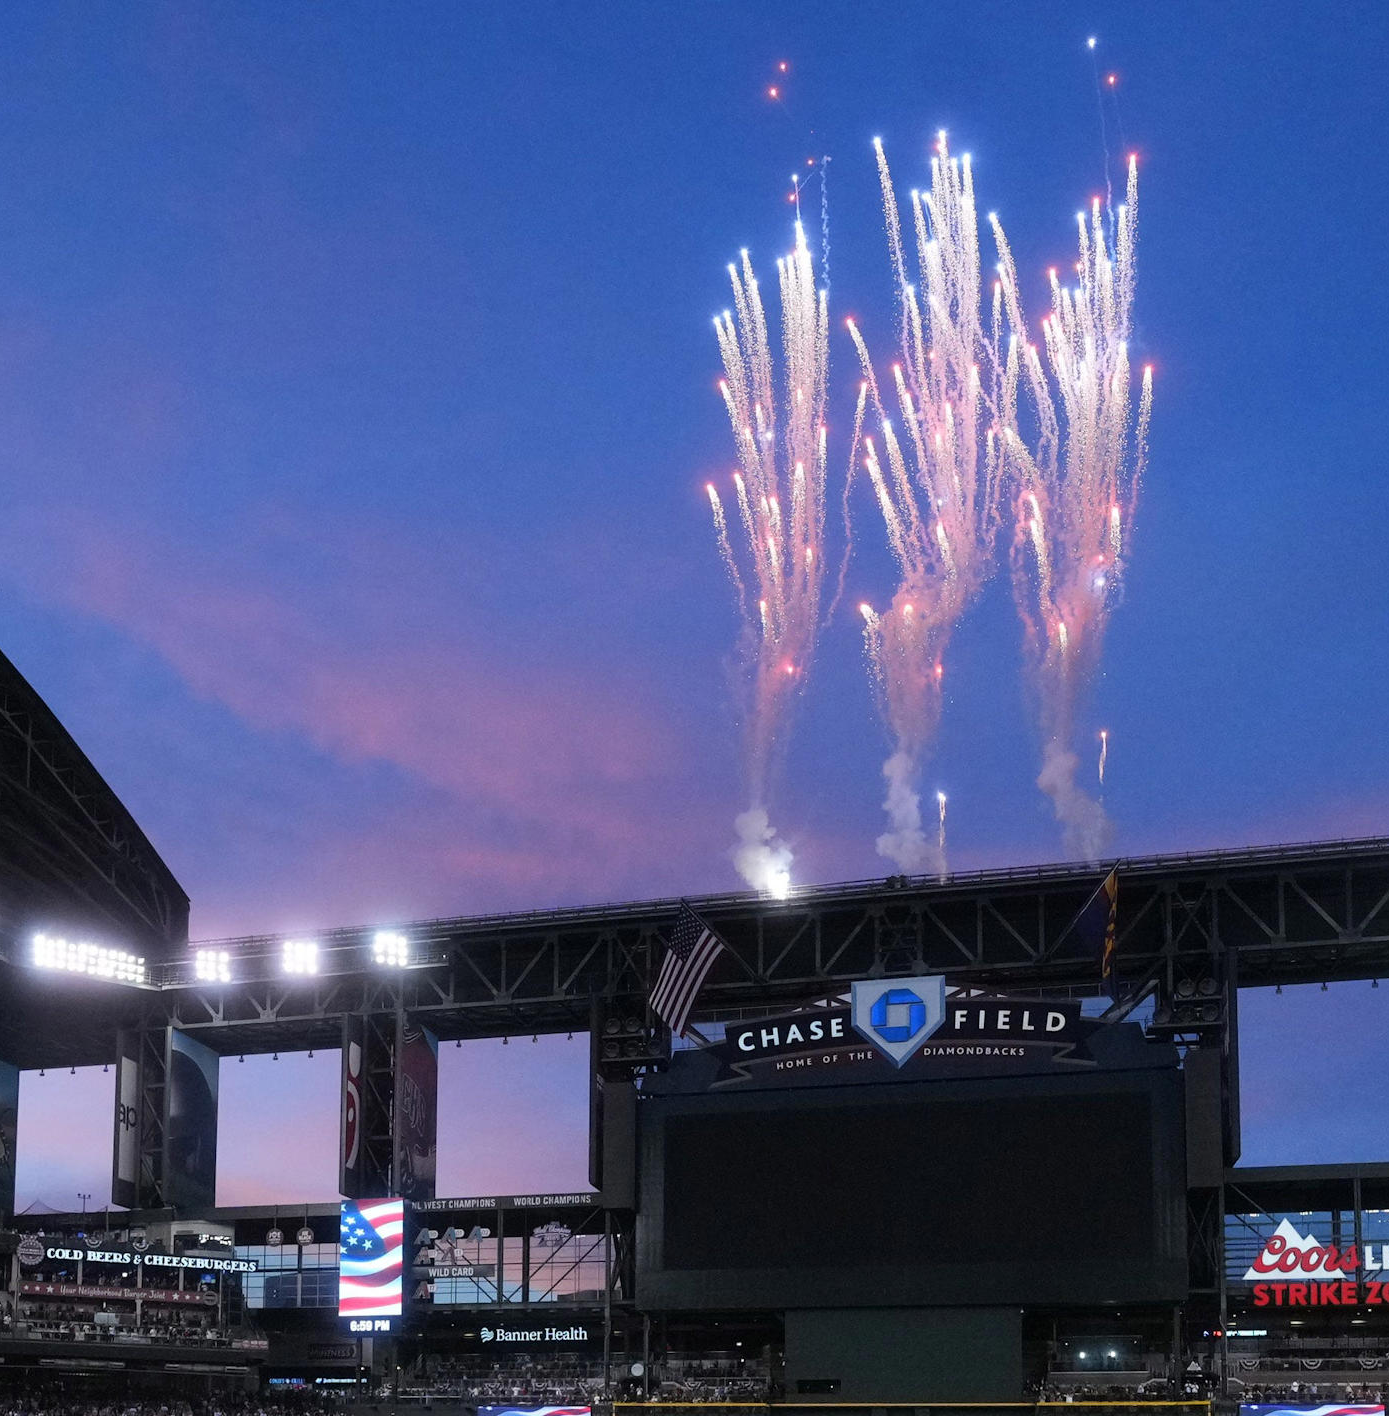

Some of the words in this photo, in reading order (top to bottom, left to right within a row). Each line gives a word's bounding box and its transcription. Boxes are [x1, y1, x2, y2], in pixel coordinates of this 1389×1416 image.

[738, 1017, 845, 1052] CHASE
[954, 1009, 1067, 1032] FIELD
[776, 1057, 813, 1070] HOME
[823, 1055, 839, 1064] OF
[849, 1051, 874, 1062] THE
[923, 1047, 1025, 1056] DIAMONDBACKS
[424, 1200, 446, 1209] WEST
[448, 1199, 496, 1209] CHAMPIONS
[514, 1197, 541, 1206] WORLD
[543, 1195, 592, 1205] CHAMPIONS
[46, 1247, 84, 1260] COLD
[86, 1250, 131, 1264] BEERS
[133, 1254, 142, 1265] &
[144, 1254, 259, 1273] CHEESEBURGERS
[1252, 1235, 1362, 1273] Coors
[429, 1268, 449, 1277] WILD
[451, 1267, 474, 1277] CARD
[60, 1285, 78, 1297] Your
[78, 1286, 123, 1298] Neighborhood
[124, 1288, 148, 1300] Burger
[148, 1289, 167, 1300] Joint
[1253, 1281, 1358, 1306] STRIKE
[350, 1320, 372, 1331] 6:59
[374, 1320, 391, 1331] PM
[495, 1328, 543, 1341] Banner
[545, 1327, 588, 1340] Health
